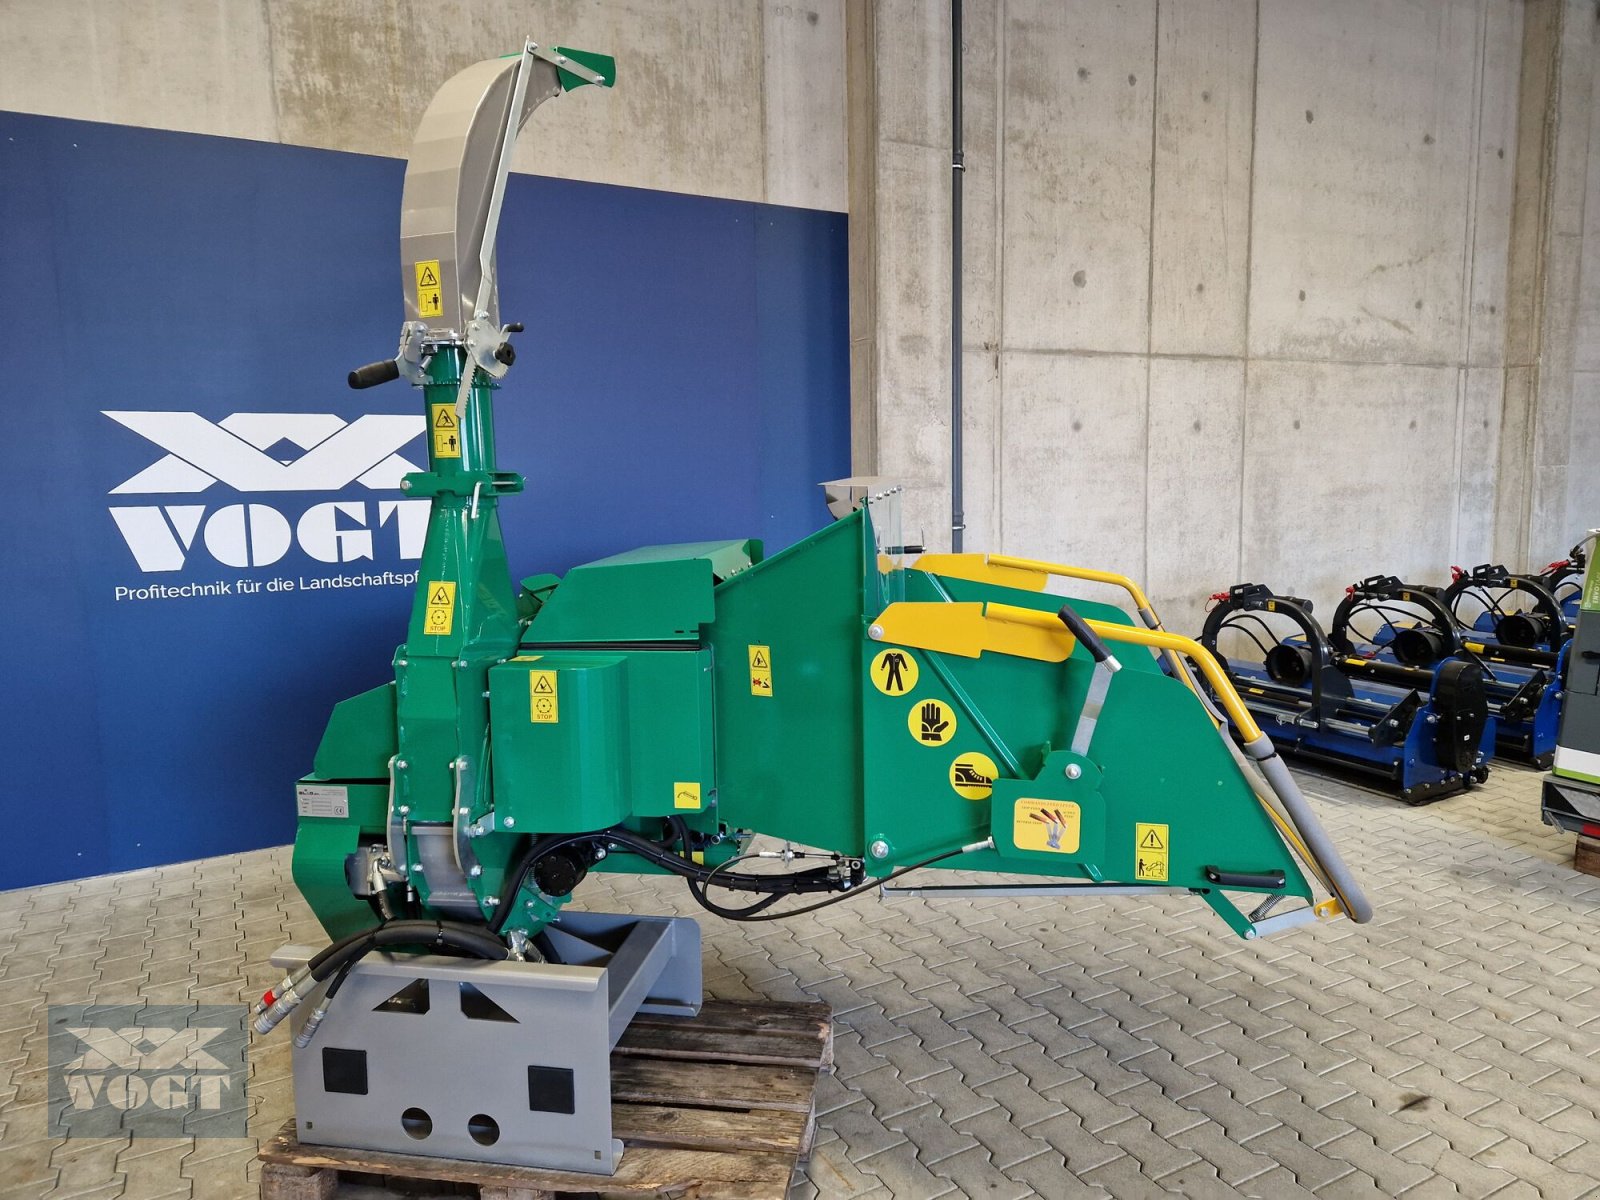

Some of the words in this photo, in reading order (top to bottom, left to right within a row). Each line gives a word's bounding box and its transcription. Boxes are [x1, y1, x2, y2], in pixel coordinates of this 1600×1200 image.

[108, 500, 433, 573] VOGT
[115, 580, 232, 601] Profitechnik
[236, 579, 263, 595] für
[266, 577, 295, 593] die
